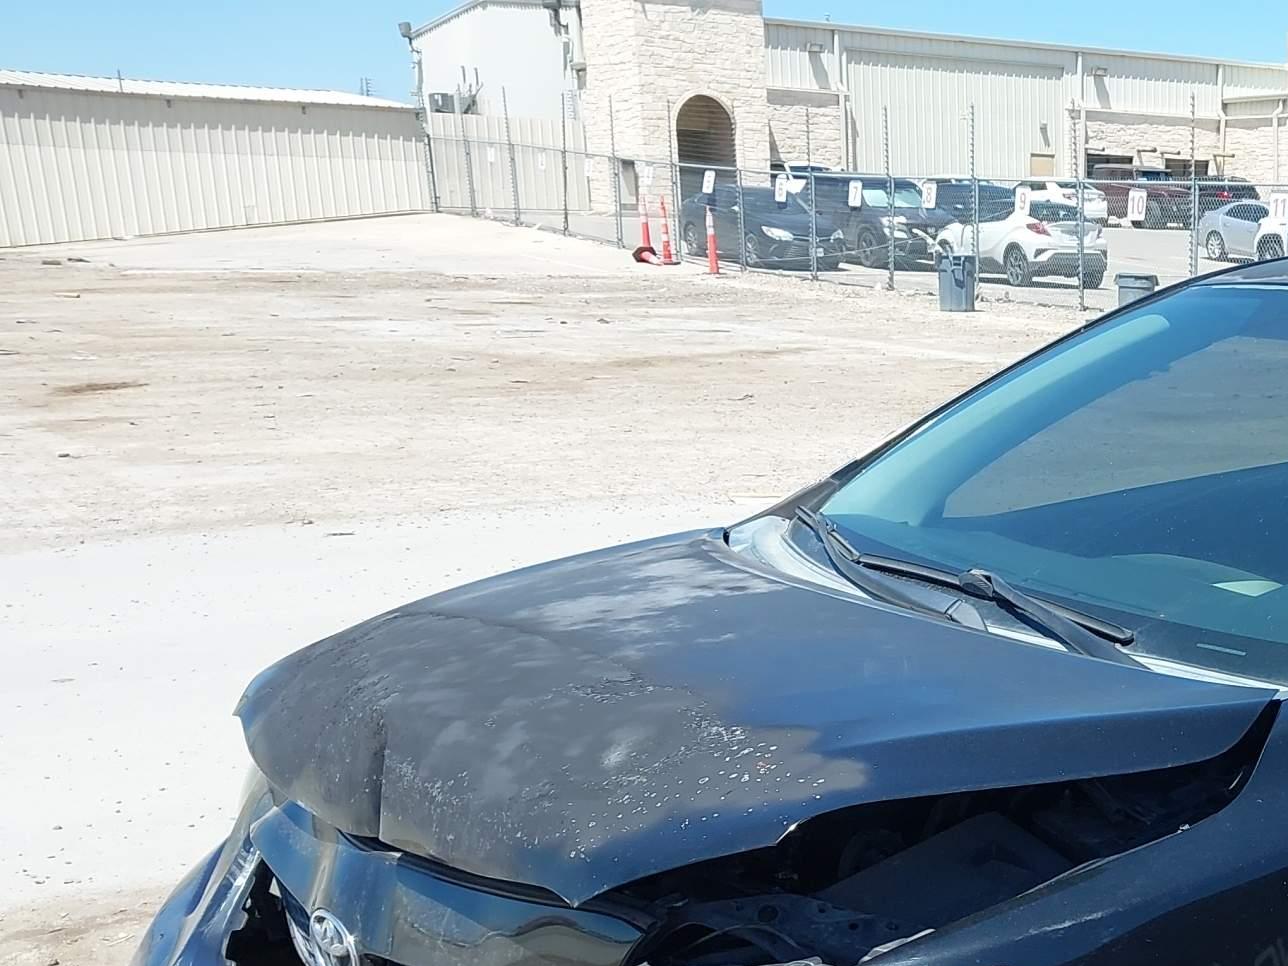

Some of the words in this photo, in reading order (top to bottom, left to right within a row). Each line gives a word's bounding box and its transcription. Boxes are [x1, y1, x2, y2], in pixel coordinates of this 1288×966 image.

[852, 186, 859, 201] 7
[926, 186, 933, 203] 8
[1019, 192, 1027, 210] 9
[1130, 195, 1145, 215] 10
[1274, 198, 1287, 217] 11
